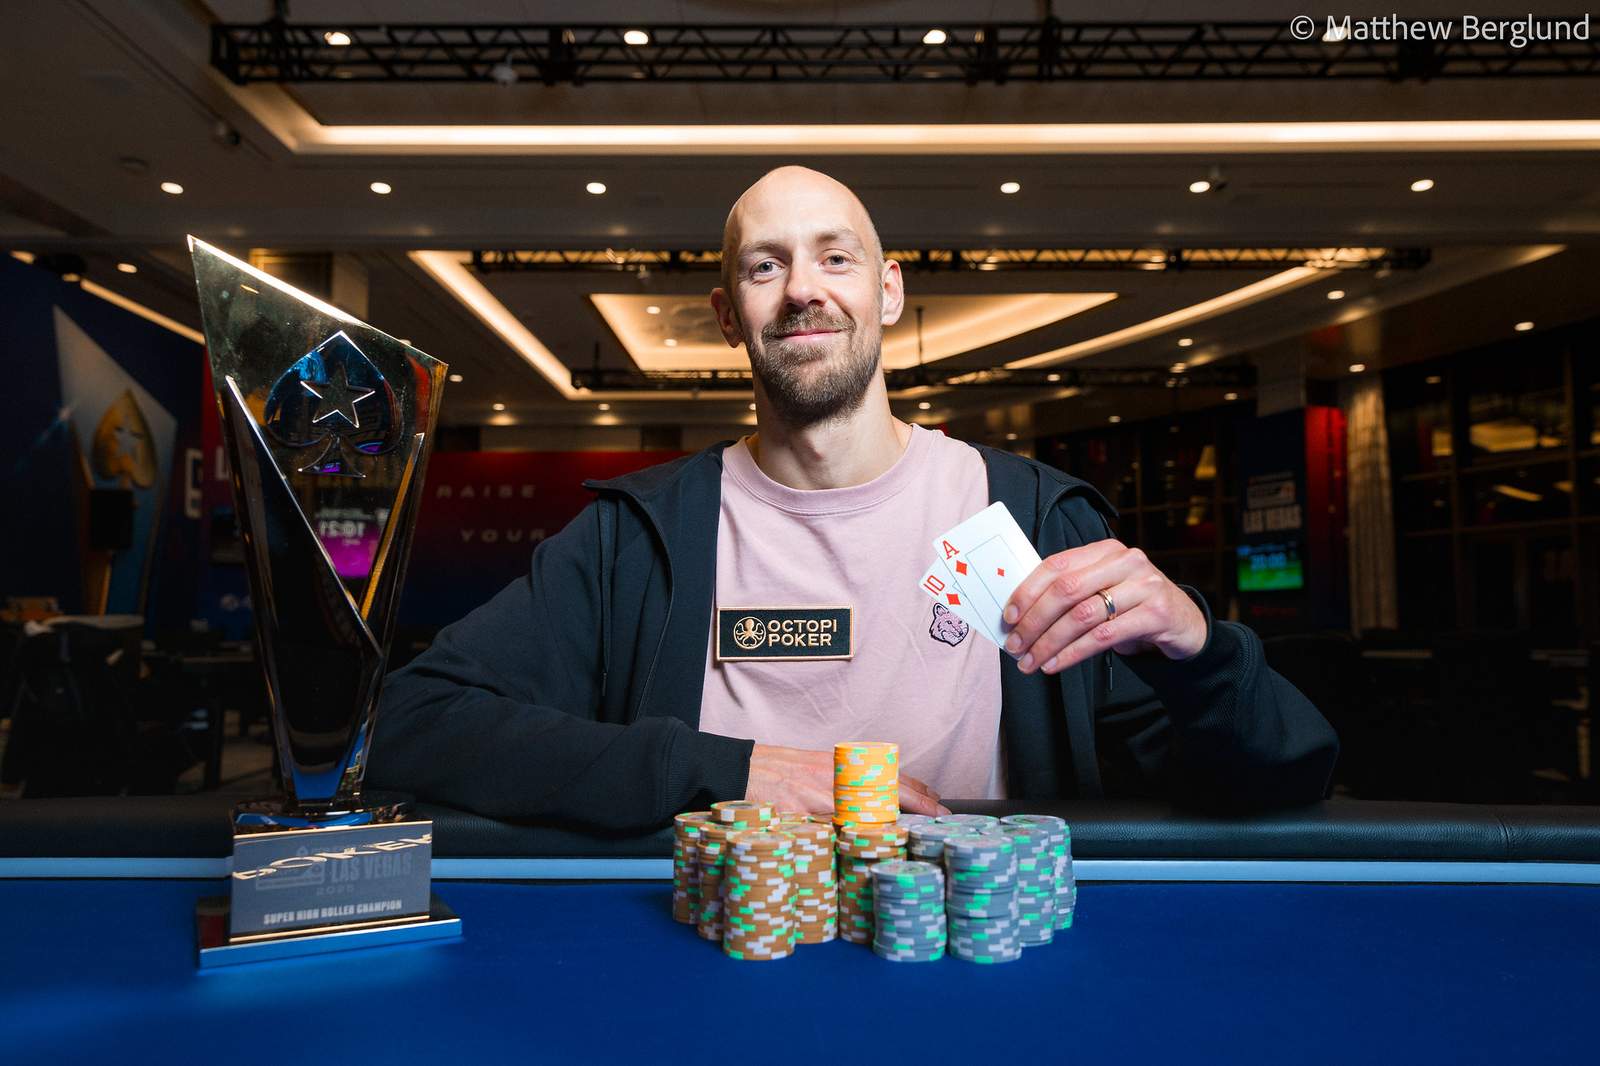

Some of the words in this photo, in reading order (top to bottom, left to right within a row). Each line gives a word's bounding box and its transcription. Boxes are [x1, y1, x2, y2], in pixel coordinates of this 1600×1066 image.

[436, 484, 537, 499] RAISE
[942, 539, 960, 560] A
[923, 574, 945, 596] 10
[767, 618, 837, 633] OCTOPI
[768, 633, 832, 647] POKER
[331, 858, 360, 883] LAS
[365, 852, 412, 880] VEGAS
[263, 910, 295, 925] SUPER
[296, 908, 320, 921] HIGH
[356, 899, 402, 915] CHAMPION
